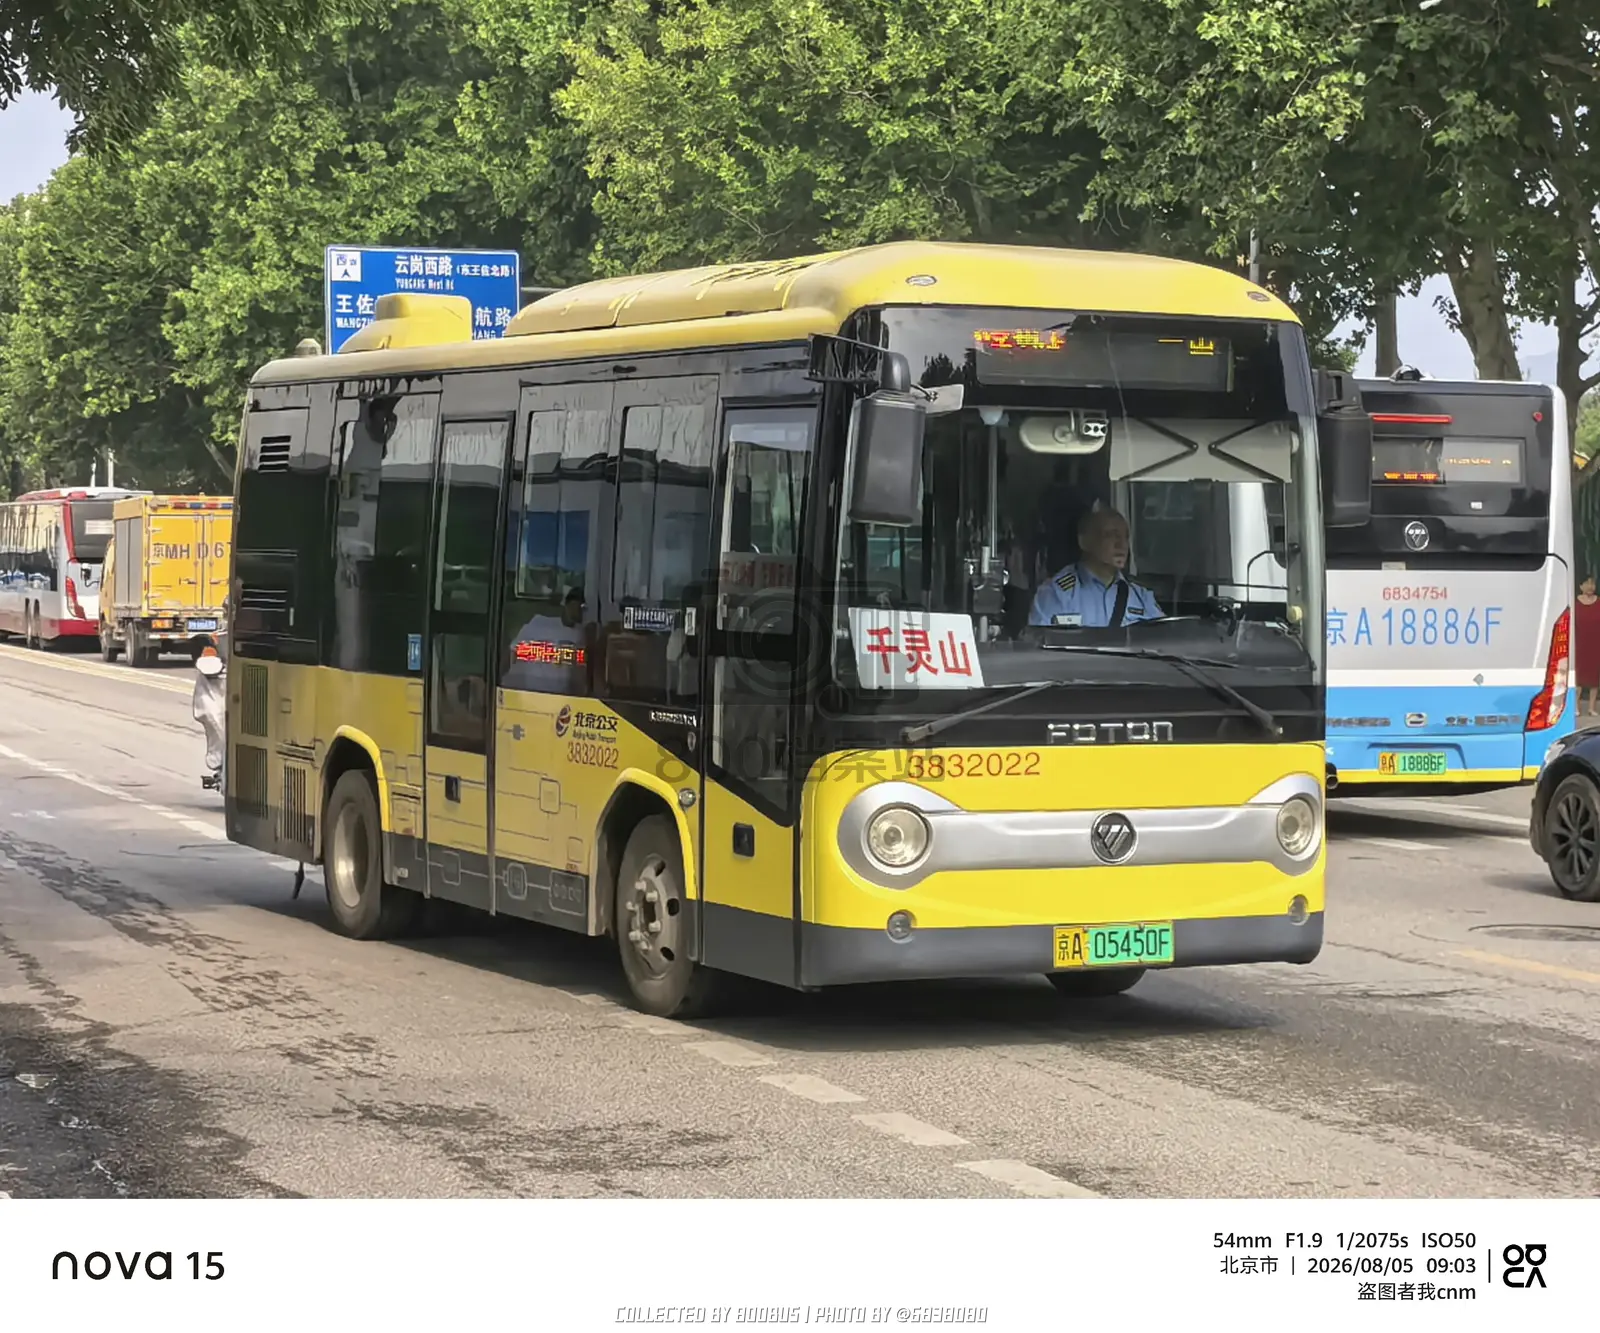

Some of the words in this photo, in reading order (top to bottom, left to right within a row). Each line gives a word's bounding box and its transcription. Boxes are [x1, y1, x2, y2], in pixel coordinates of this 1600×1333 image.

[395, 255, 453, 276] 云岗西路
[1382, 587, 1447, 601] 6834754
[866, 627, 972, 676] 千灵山
[574, 712, 618, 732] 北京公交
[1047, 721, 1173, 744] FOTON
[567, 741, 619, 769] 3832022
[908, 752, 1041, 780] 3832022
